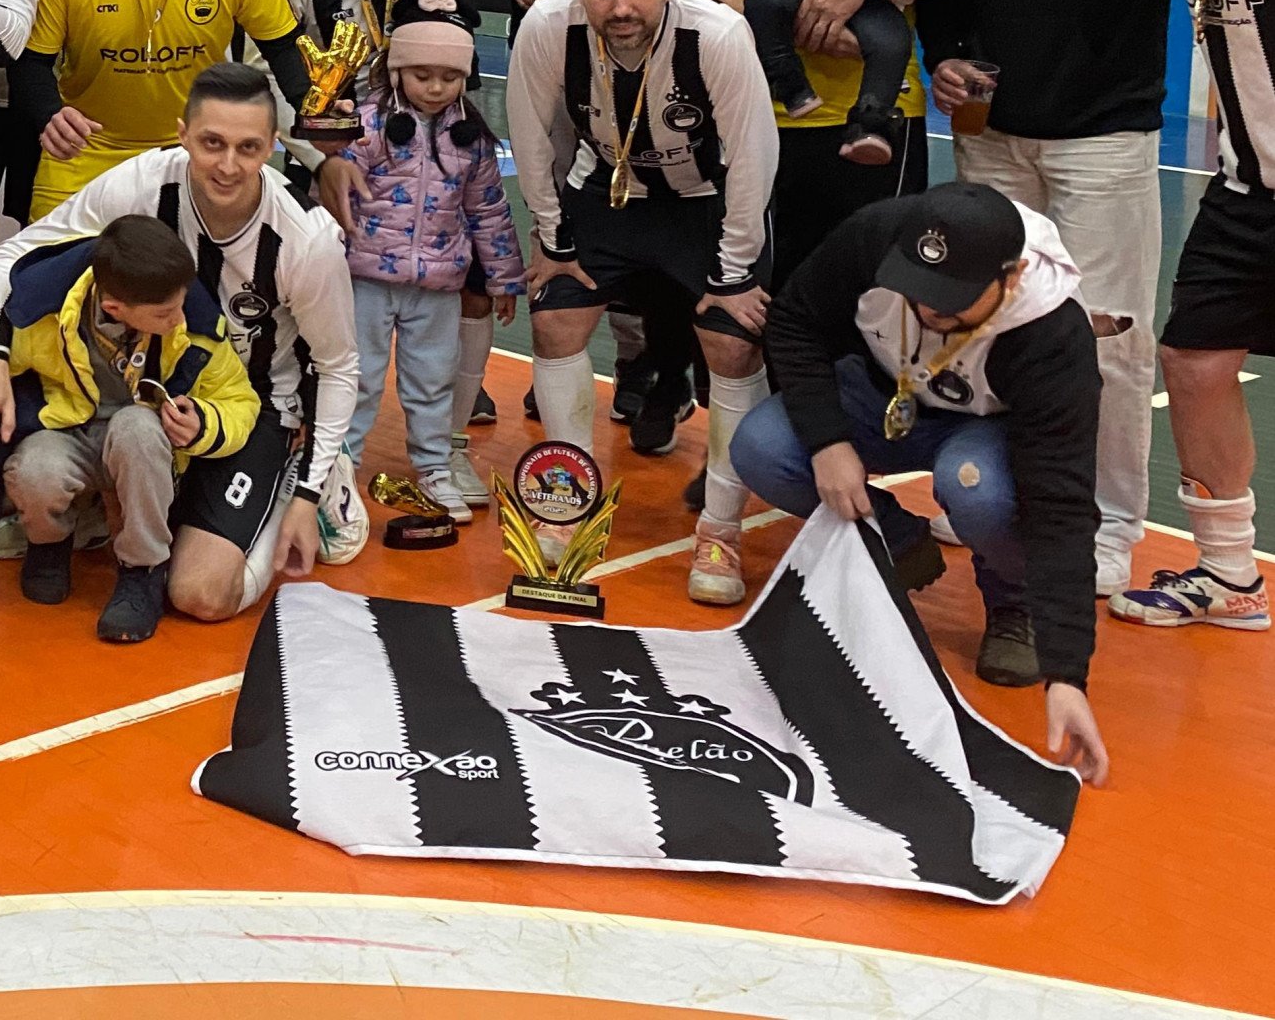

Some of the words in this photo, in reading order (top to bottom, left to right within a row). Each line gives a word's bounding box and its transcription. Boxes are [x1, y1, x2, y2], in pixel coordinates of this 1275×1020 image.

[100, 44, 207, 63] ROLOFF
[224, 471, 253, 510] 8
[531, 491, 582, 506] VETERANOS
[521, 588, 556, 600] DESTAQUE
[568, 595, 588, 603] FINAL
[458, 769, 500, 781] sport
